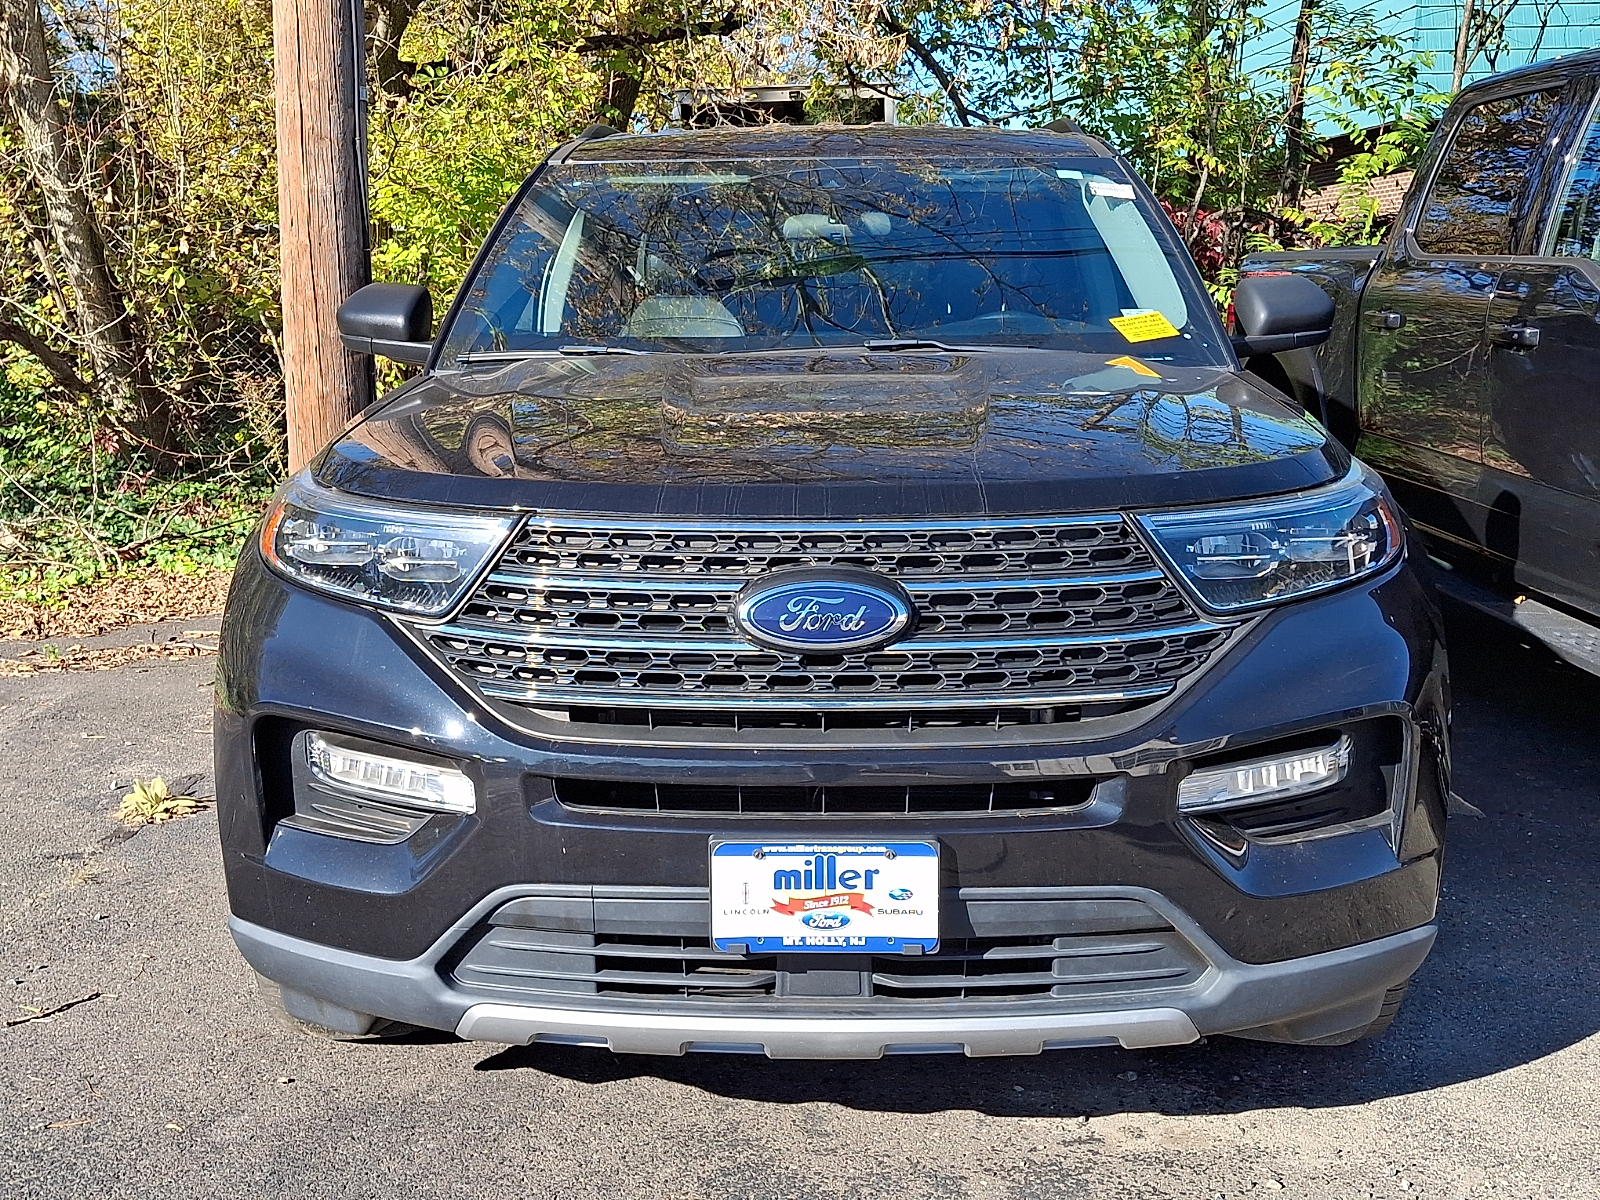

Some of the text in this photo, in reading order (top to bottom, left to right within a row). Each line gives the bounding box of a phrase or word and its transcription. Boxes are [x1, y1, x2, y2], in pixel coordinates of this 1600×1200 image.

[779, 596, 866, 632] Ford
[774, 855, 880, 890] miller
[803, 895, 850, 910] Since 1912
[877, 908, 924, 916] SUBARU
[808, 912, 842, 928] Ford
[782, 936, 866, 948] MT. HOLLY, NJ
